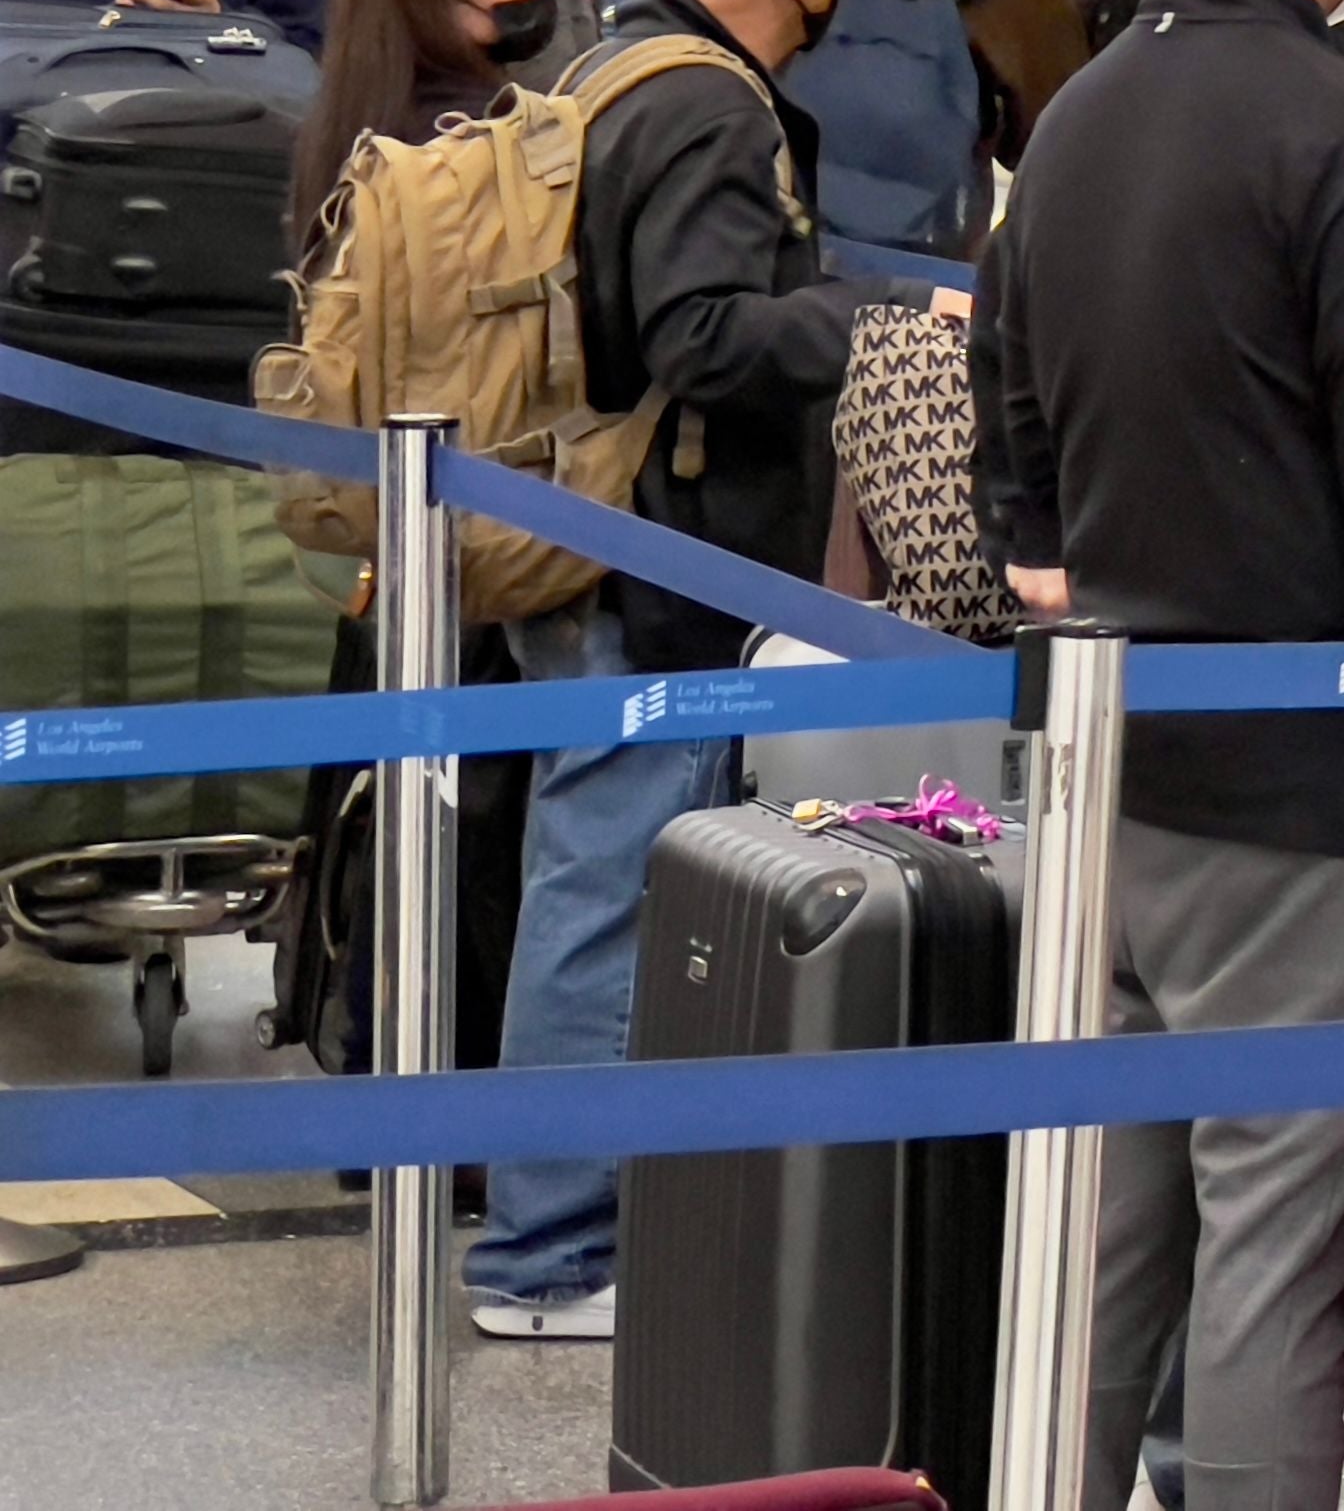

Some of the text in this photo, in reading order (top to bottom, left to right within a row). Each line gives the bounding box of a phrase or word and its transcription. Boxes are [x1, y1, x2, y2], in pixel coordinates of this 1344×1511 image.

[863, 328, 945, 354] MK MK
[884, 350, 921, 376] MK
[861, 380, 898, 409] MK
[903, 374, 946, 400] MK
[883, 404, 922, 432] MK
[928, 399, 970, 426] MK
[865, 434, 899, 465] MK
[904, 428, 947, 455] MK
[885, 459, 924, 488] MK
[868, 489, 900, 518] MK
[905, 483, 948, 510] MK
[886, 510, 974, 541] MK MK
[905, 540, 950, 567] MK
[930, 566, 973, 593] MK
[910, 597, 948, 622] MK
[953, 594, 992, 619] MK
